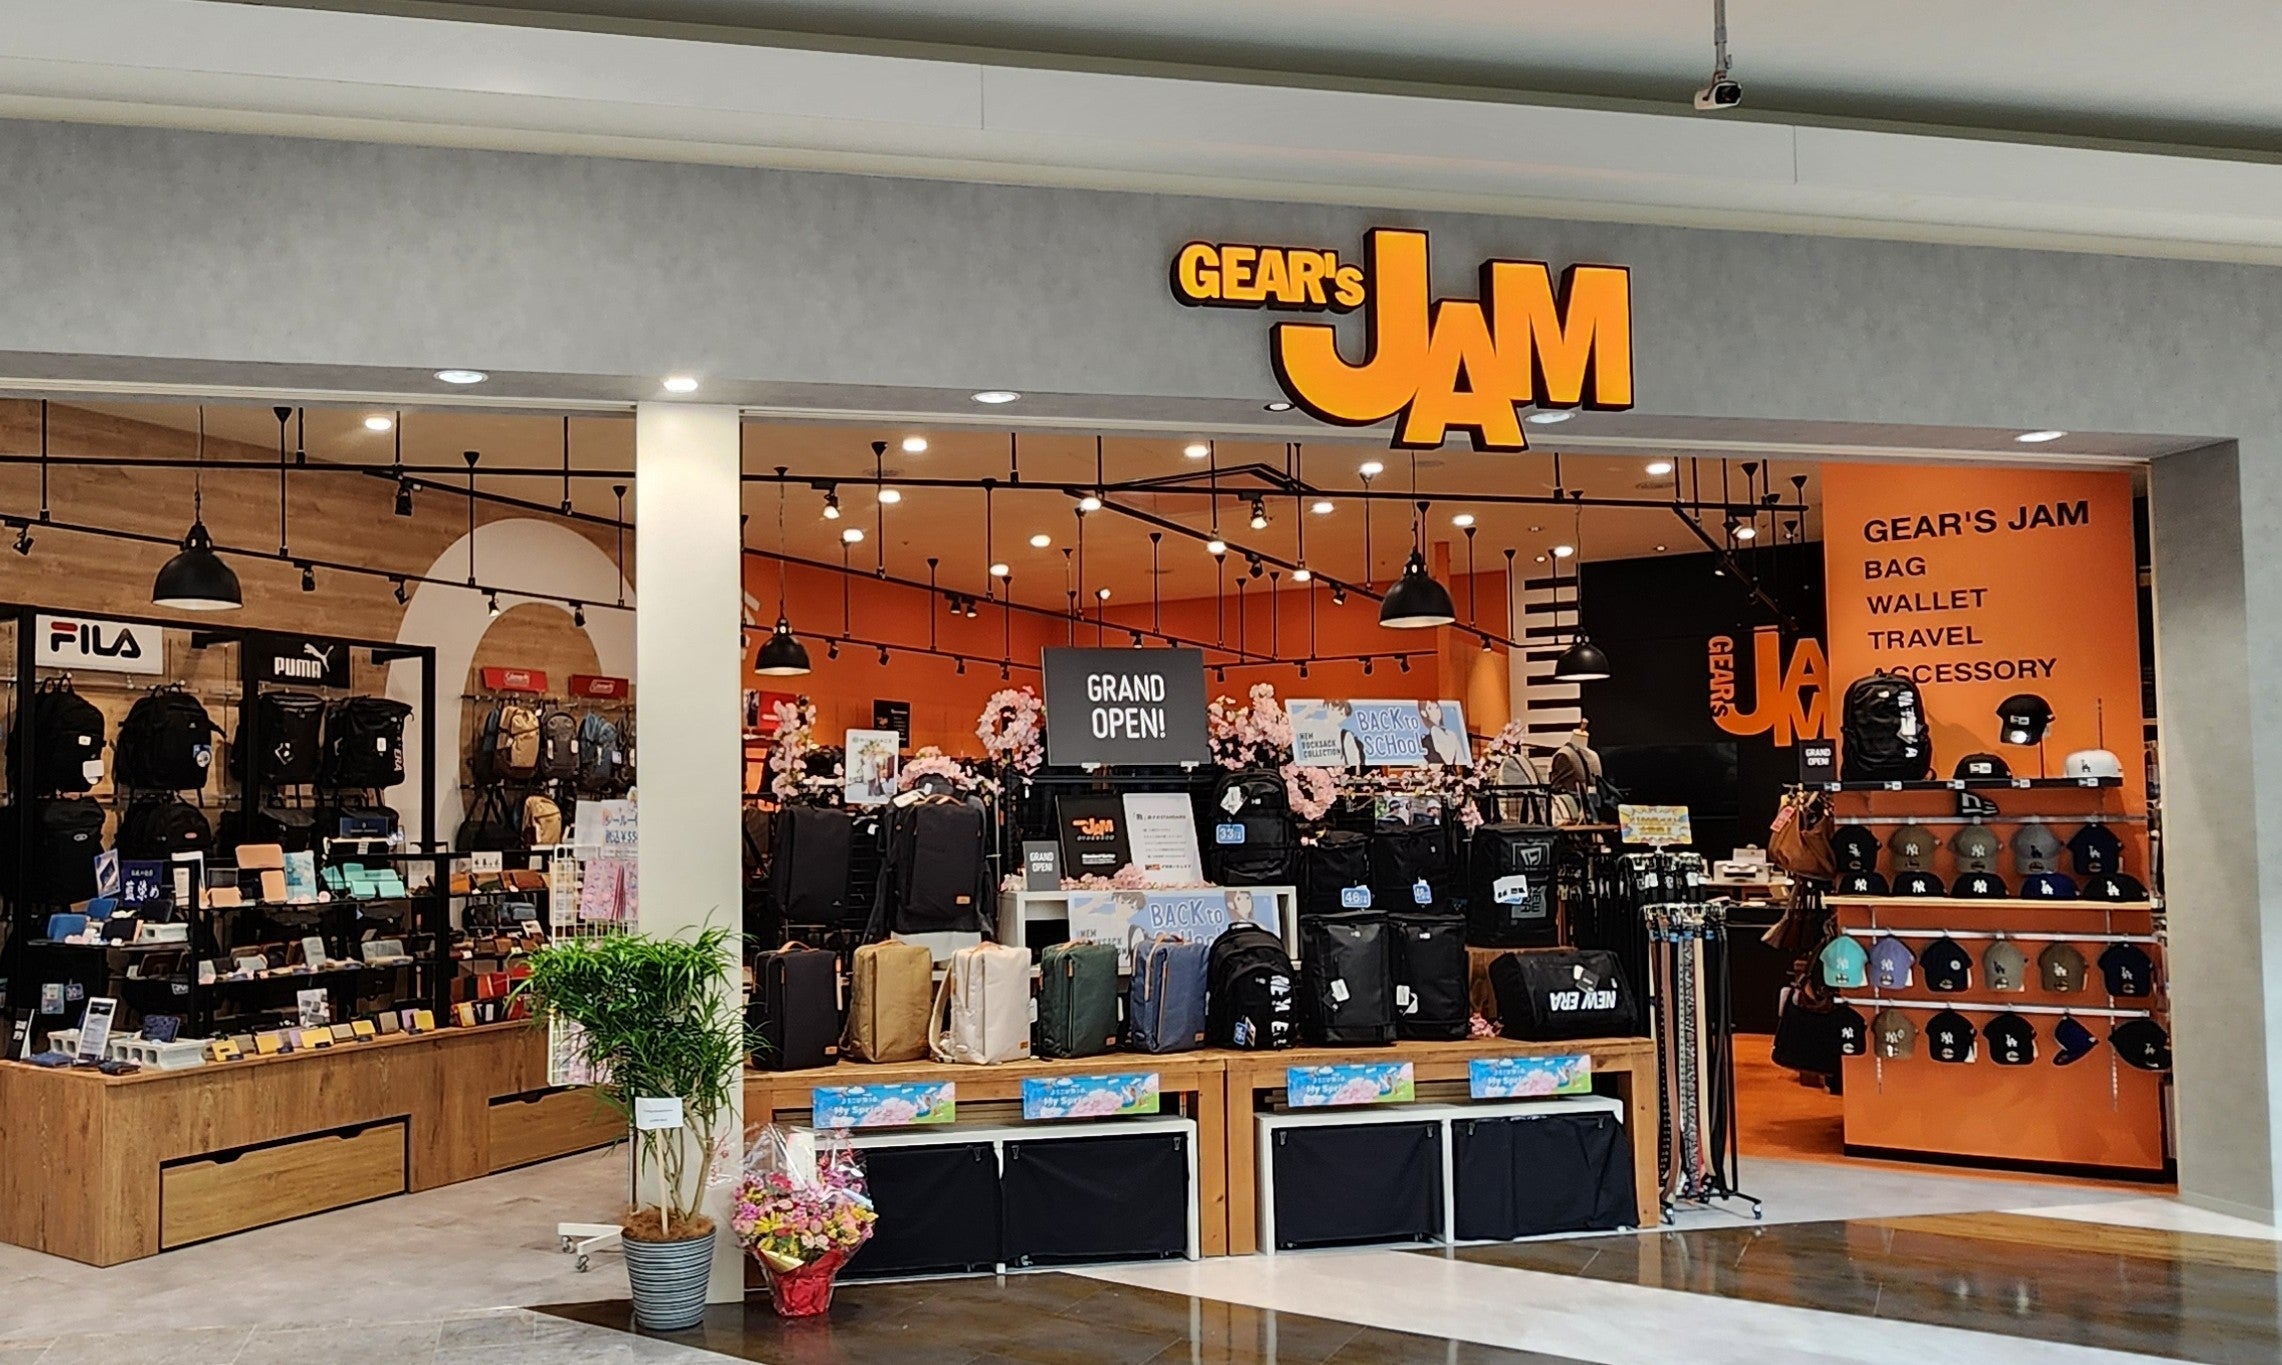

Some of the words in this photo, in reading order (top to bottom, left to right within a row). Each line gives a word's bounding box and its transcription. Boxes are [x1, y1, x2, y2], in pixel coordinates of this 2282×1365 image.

[1174, 242, 1366, 310] GEAR's
[1277, 229, 1633, 449] JAM
[1864, 509, 1997, 543] GEAR'S
[2008, 500, 2089, 531] JAM
[1864, 557, 1926, 580] BAG
[1866, 588, 1988, 614] WALLET
[51, 621, 141, 658] FILA
[1867, 626, 1983, 649] TRAVEL
[274, 657, 321, 678] PUMA
[1087, 674, 1165, 702] GRAND
[1092, 707, 1166, 739] OPEN!
[1357, 707, 1401, 730] BACK
[1405, 716, 1418, 730] to
[1029, 851, 1054, 862] GRAND
[1151, 900, 1204, 927] BACK
[1207, 908, 1223, 923] to
[1550, 991, 1580, 1012] ERA
[1581, 990, 1617, 1010] NEW
